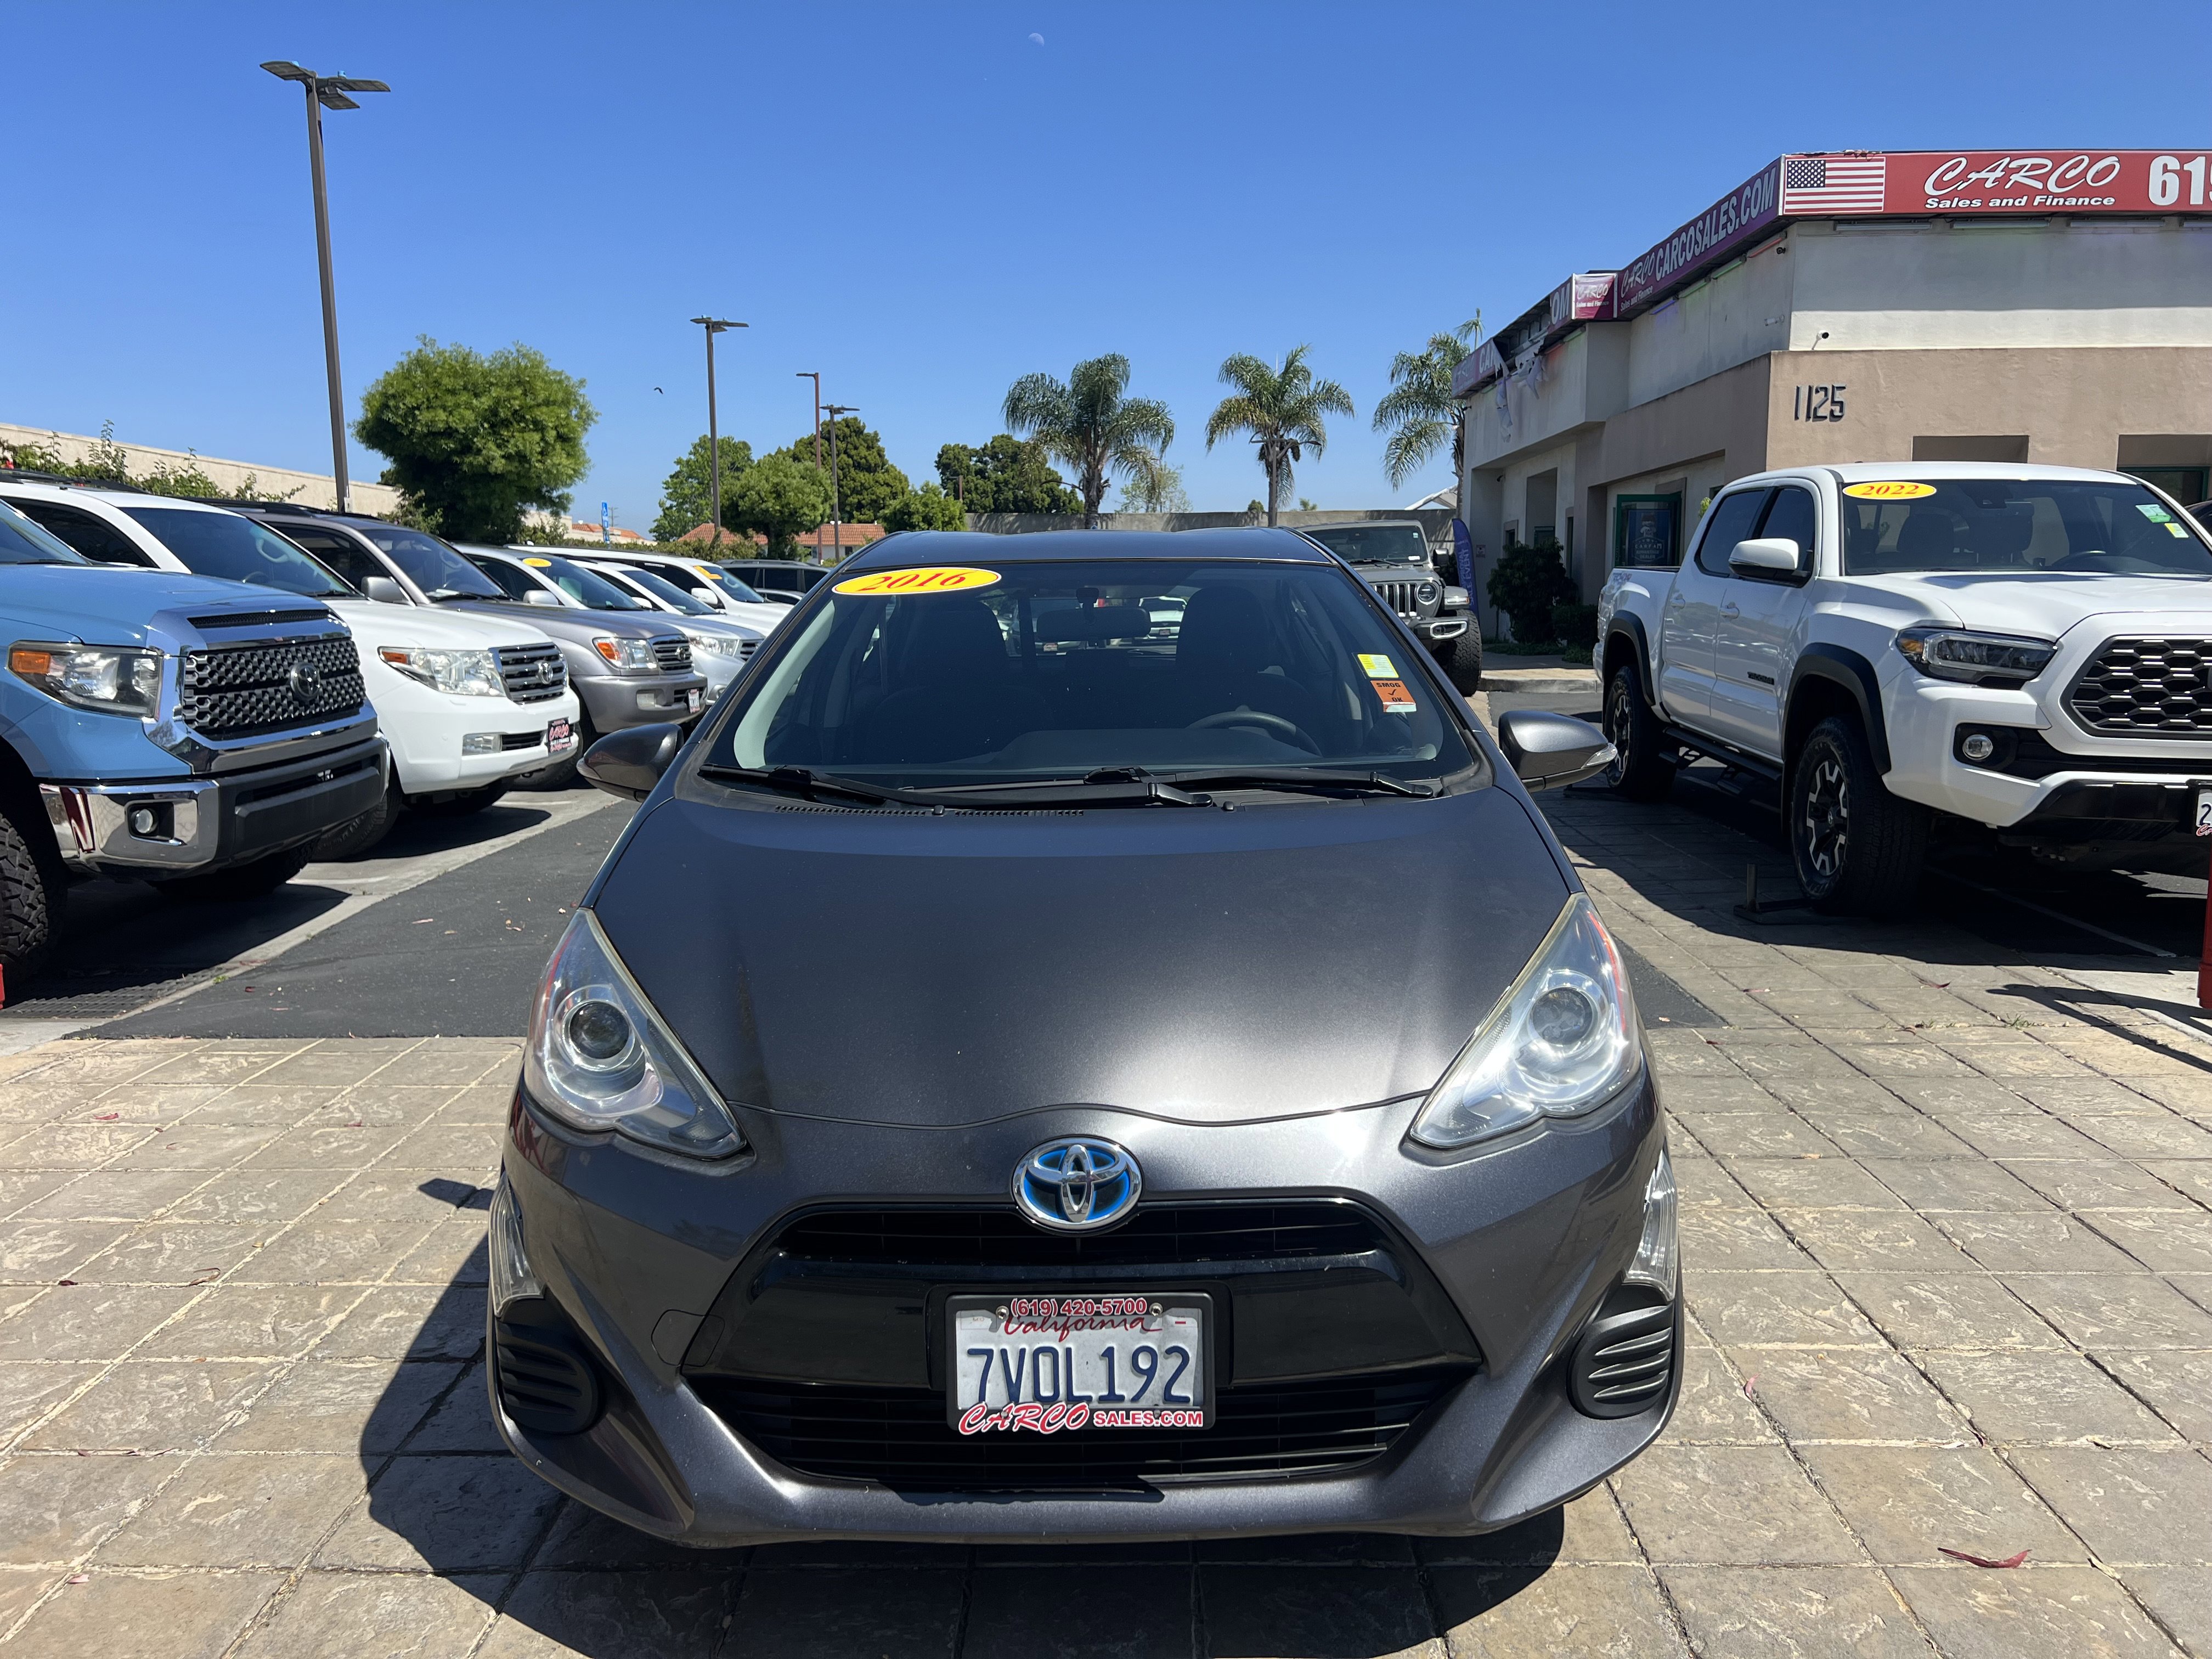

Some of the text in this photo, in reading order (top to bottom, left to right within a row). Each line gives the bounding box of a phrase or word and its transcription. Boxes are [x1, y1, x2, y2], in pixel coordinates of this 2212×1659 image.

[1924, 155, 2121, 196] CARCO
[2148, 155, 2212, 206] 61
[1925, 194, 2115, 209] Sales and Finance
[1621, 166, 1776, 298] CARCO CARCOSALES.COM
[1577, 284, 1609, 300] CARCO
[1795, 384, 1847, 422] 1125
[1860, 485, 1919, 495] 2022
[856, 571, 977, 591] 2016
[1011, 1297, 1148, 1317] (619) 420-5700
[1004, 1315, 1163, 1342] California
[967, 1346, 1190, 1403] 7VOL192
[958, 1402, 1203, 1435] CARCO SALES.COM
